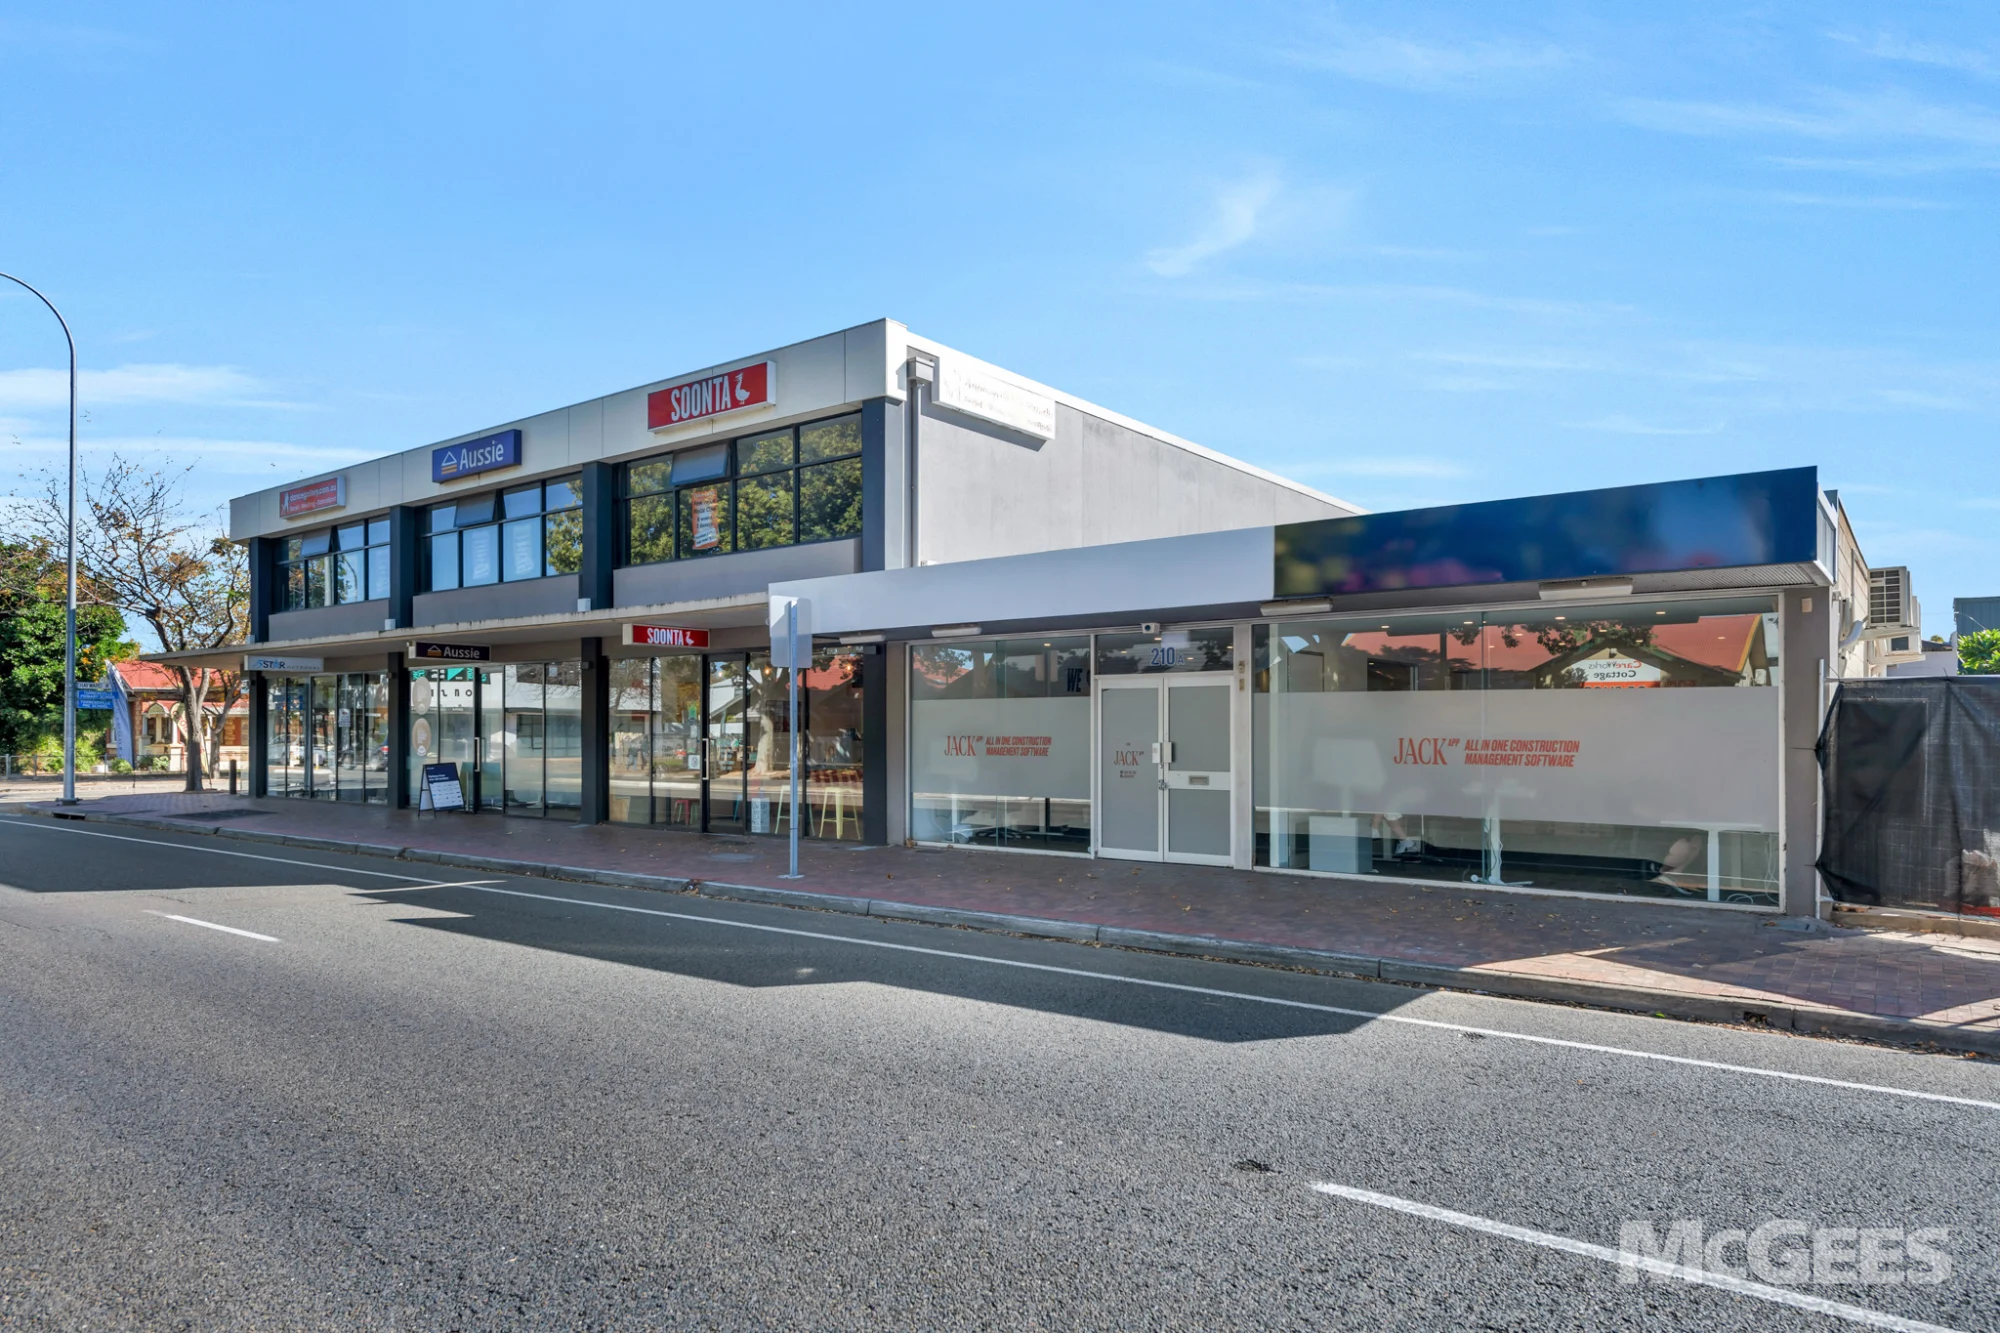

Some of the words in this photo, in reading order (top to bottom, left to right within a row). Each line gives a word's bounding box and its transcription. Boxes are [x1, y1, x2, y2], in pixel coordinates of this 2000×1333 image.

[671, 376, 731, 421] SOONTA
[460, 440, 504, 470] Aussie
[647, 628, 683, 645] SOONTA
[444, 646, 480, 658] Aussie
[944, 735, 977, 757] JACK
[985, 736, 995, 745] ALL
[1012, 736, 1053, 746] CONSTRUCTION
[1464, 739, 1480, 751] ALL
[1481, 740, 1490, 751] IN
[1491, 740, 1509, 752] ONE
[1509, 740, 1580, 753] CONSTRUCTION
[985, 747, 1020, 757] MANAGEMENT
[1020, 747, 1049, 757] SOFTWARE
[1114, 751, 1138, 766] JACK
[1393, 738, 1447, 765] JACK
[1448, 739, 1460, 747] APP
[1464, 753, 1523, 766] MANAGEMENT
[1524, 754, 1575, 767] SOFTWARE
